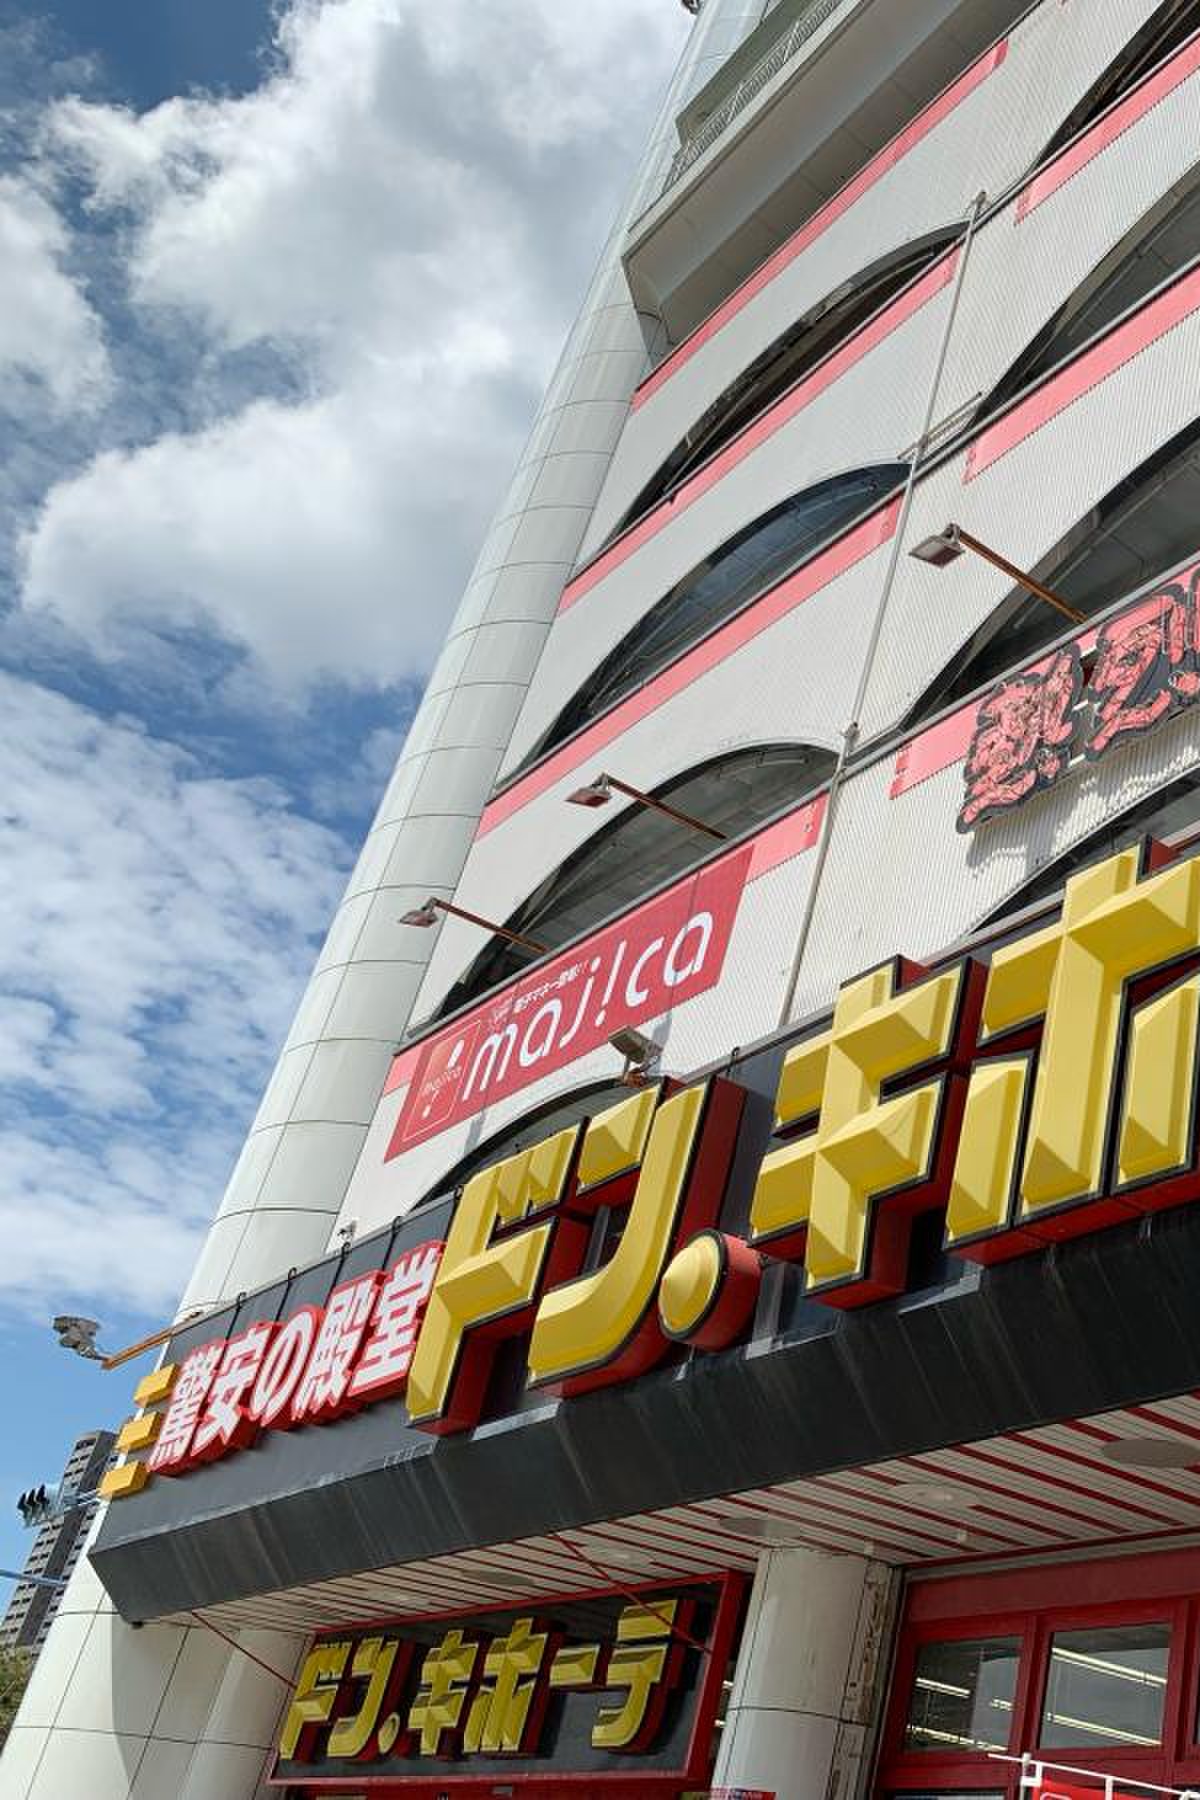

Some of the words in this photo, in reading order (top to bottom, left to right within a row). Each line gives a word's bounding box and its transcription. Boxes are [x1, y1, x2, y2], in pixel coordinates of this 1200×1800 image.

[147, 1240, 447, 1476] 驚安の殿堂
